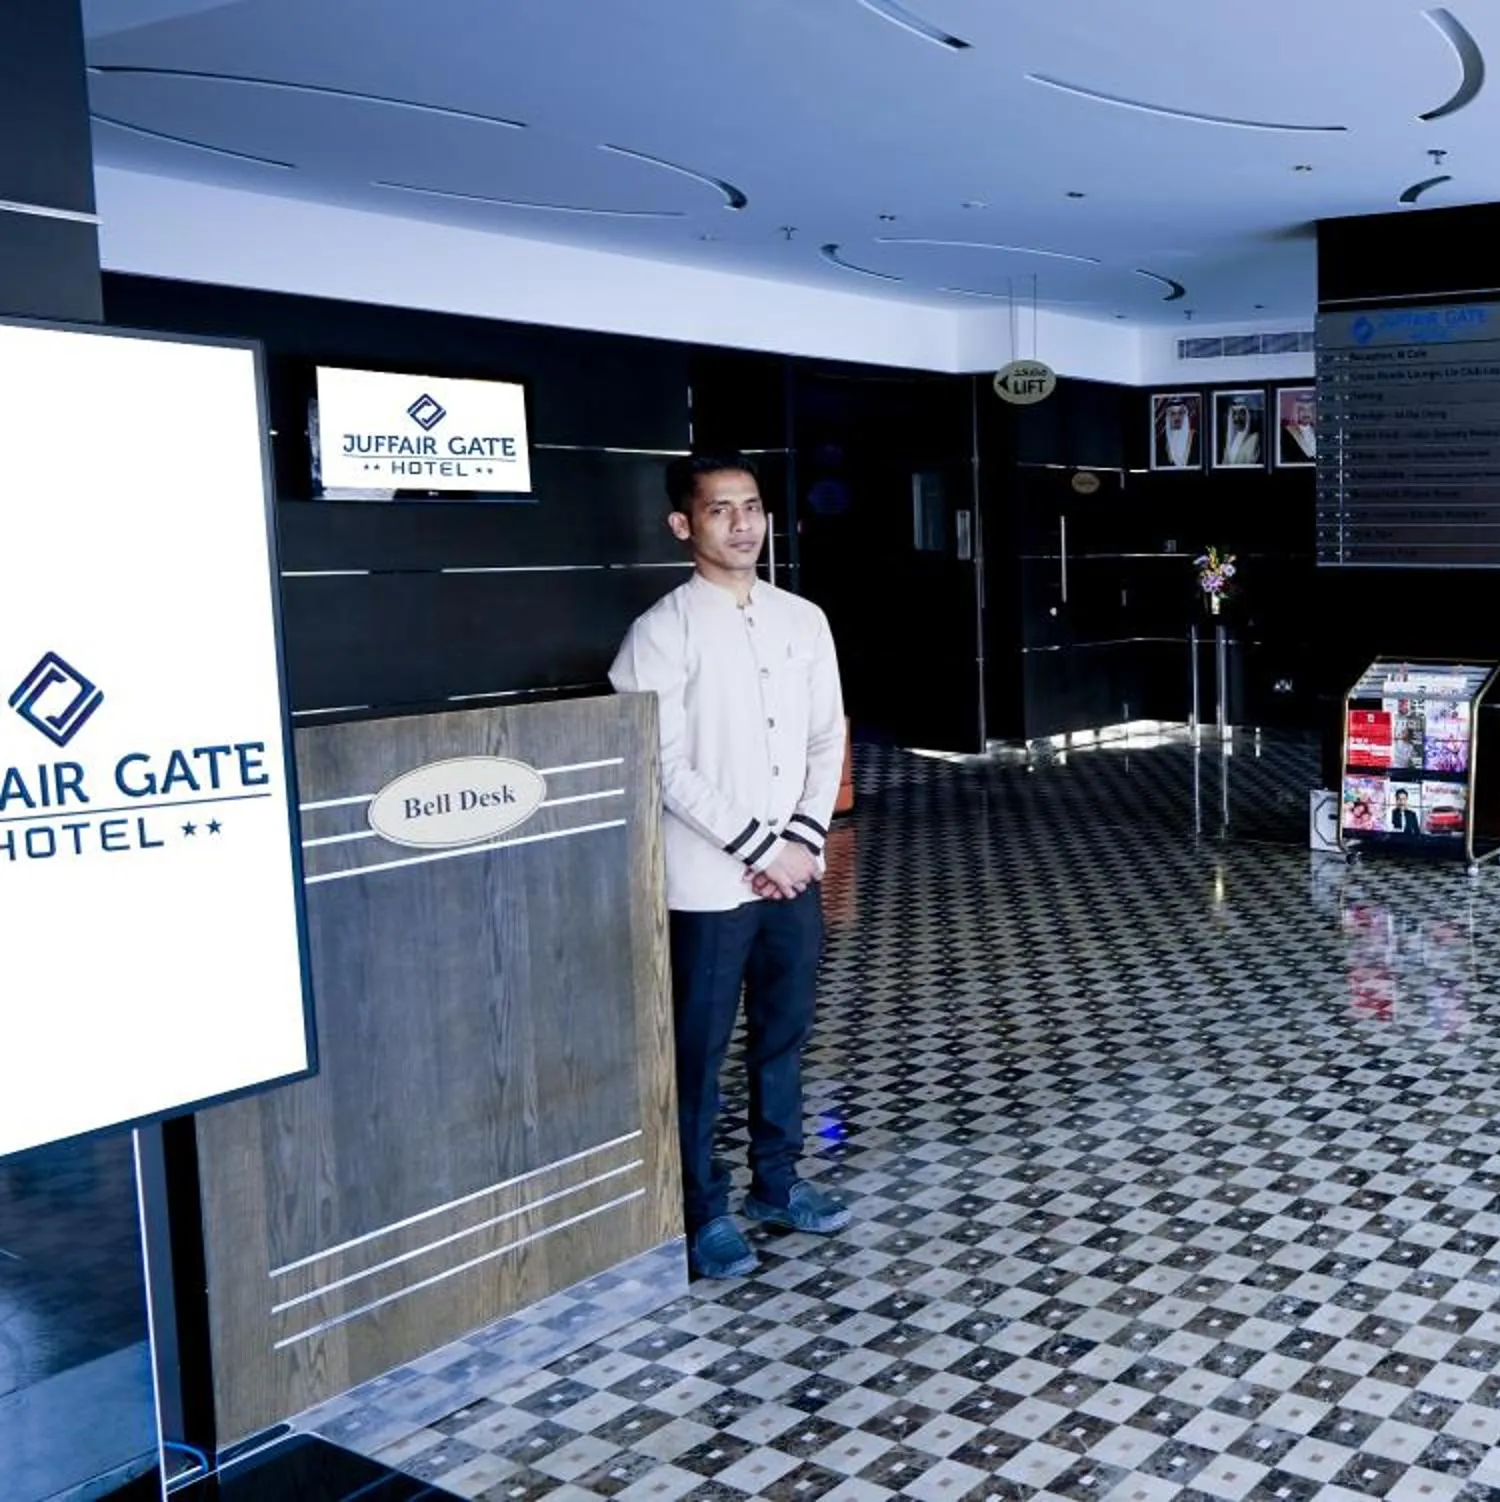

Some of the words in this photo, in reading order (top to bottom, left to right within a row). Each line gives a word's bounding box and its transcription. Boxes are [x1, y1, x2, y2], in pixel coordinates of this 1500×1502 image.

[1014, 379, 1046, 394] LIFT
[343, 434, 438, 455] JUFFAIR
[447, 436, 516, 457] GATE
[391, 461, 468, 477] HOTEL
[114, 741, 269, 798] GATE
[404, 793, 451, 819] Bell
[460, 785, 517, 811] Desk
